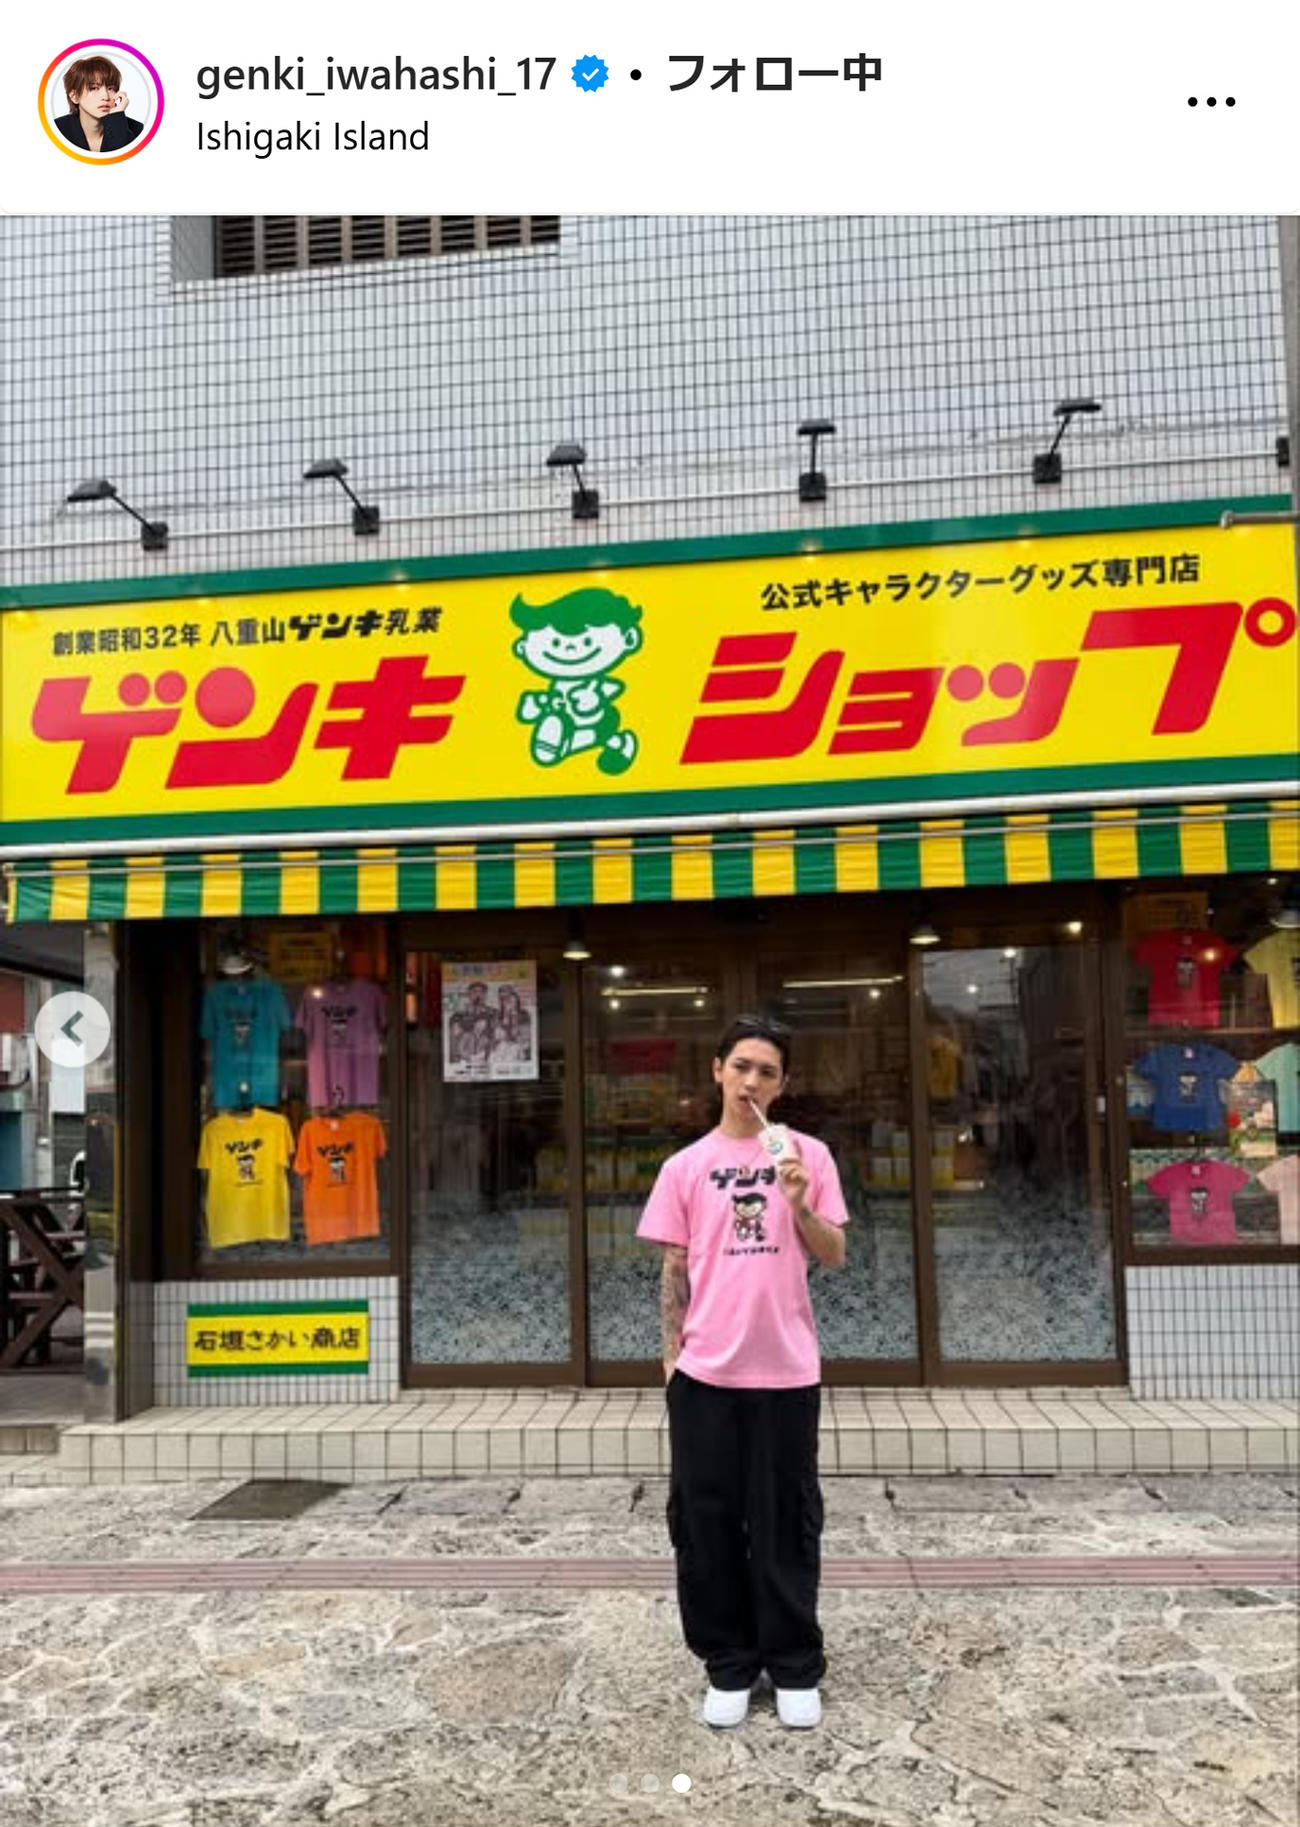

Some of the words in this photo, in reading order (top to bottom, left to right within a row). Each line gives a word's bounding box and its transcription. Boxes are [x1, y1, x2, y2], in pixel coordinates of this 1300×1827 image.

[761, 552, 1200, 612] 公式キャラクターグッズ専門店
[53, 623, 201, 656] 創業昭和32年
[209, 605, 443, 646] 八重山ゲンキ乳業
[32, 656, 466, 794] ゲンキ
[680, 598, 1297, 765] ショップ
[194, 1327, 361, 1352] 石垣さかい商店
